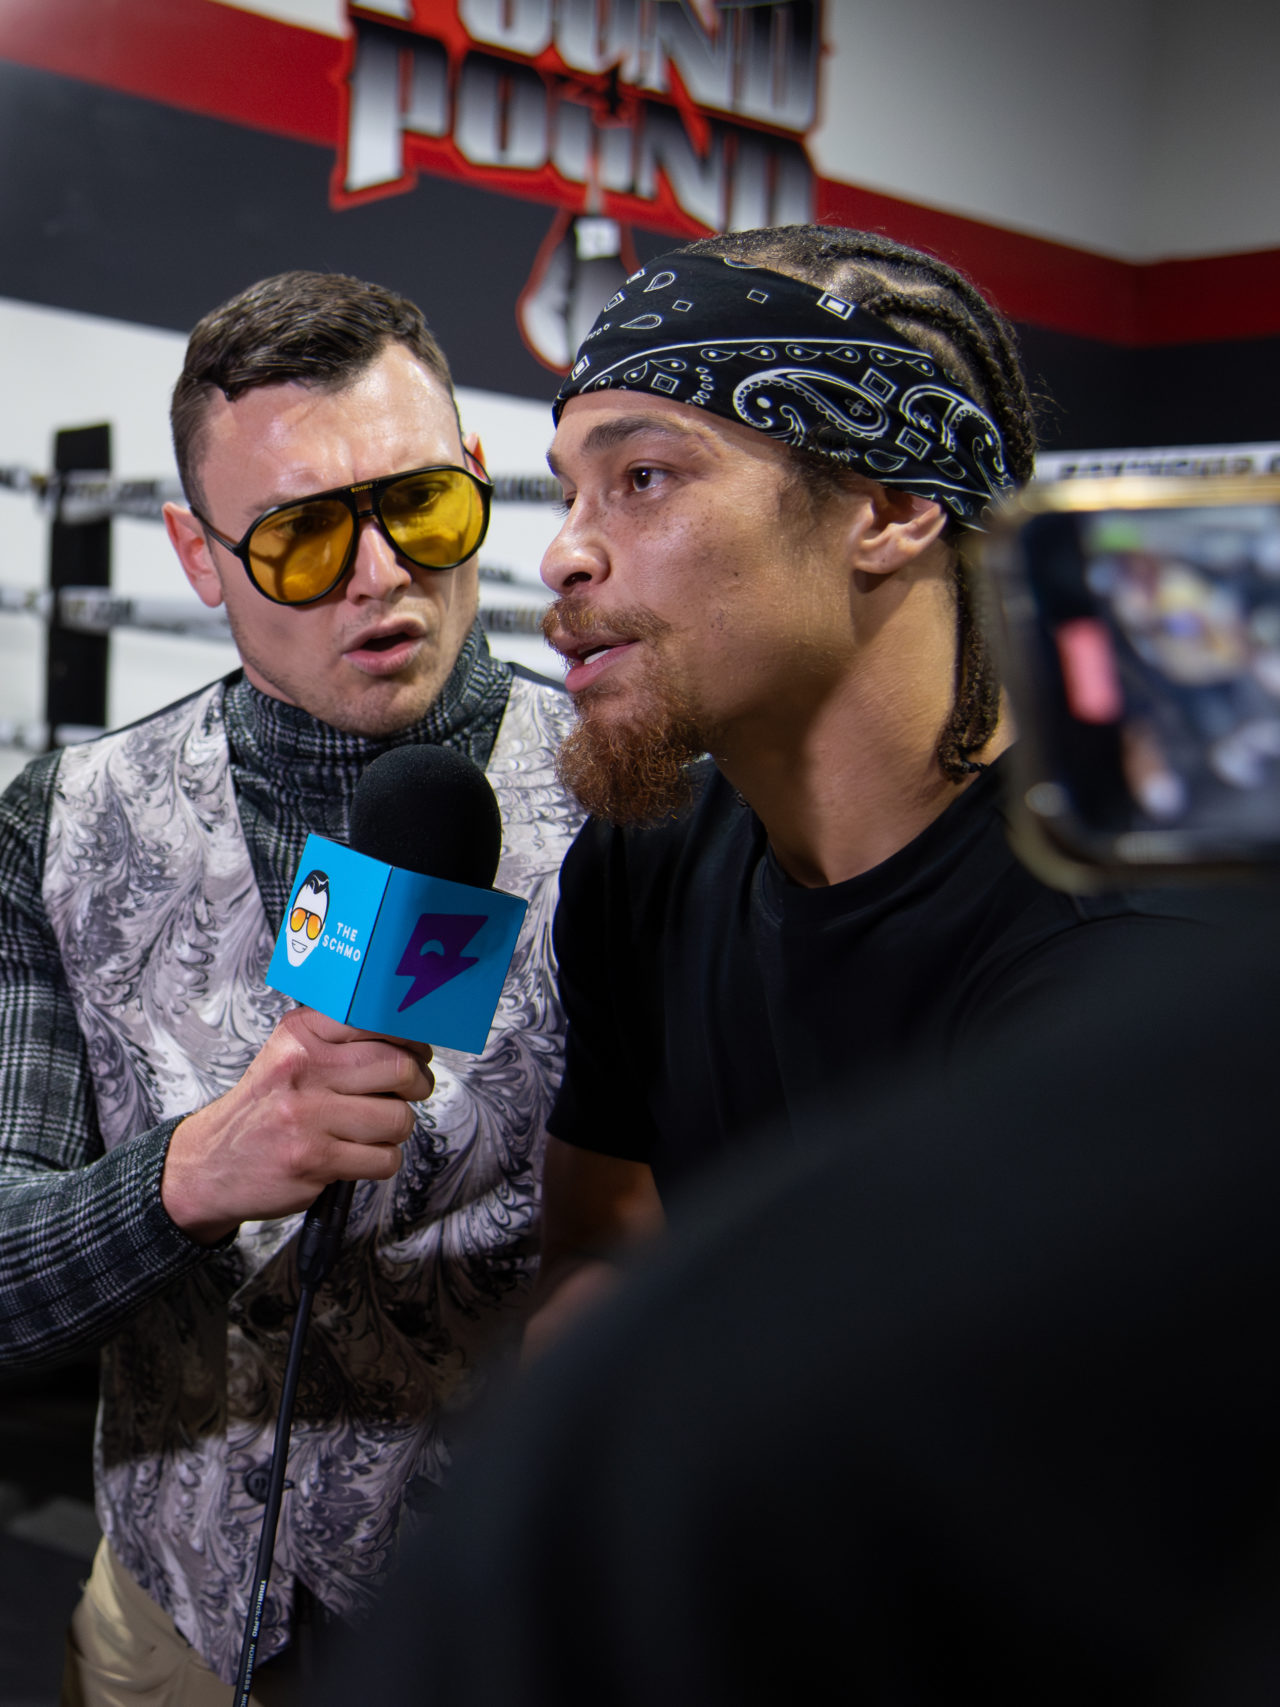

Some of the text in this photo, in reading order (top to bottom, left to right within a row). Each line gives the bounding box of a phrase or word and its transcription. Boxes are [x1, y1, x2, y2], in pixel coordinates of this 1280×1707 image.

[350, 0, 818, 137] OUND
[346, 17, 816, 233] POUND
[322, 934, 361, 962] SCHMO
[336, 921, 358, 942] THE
